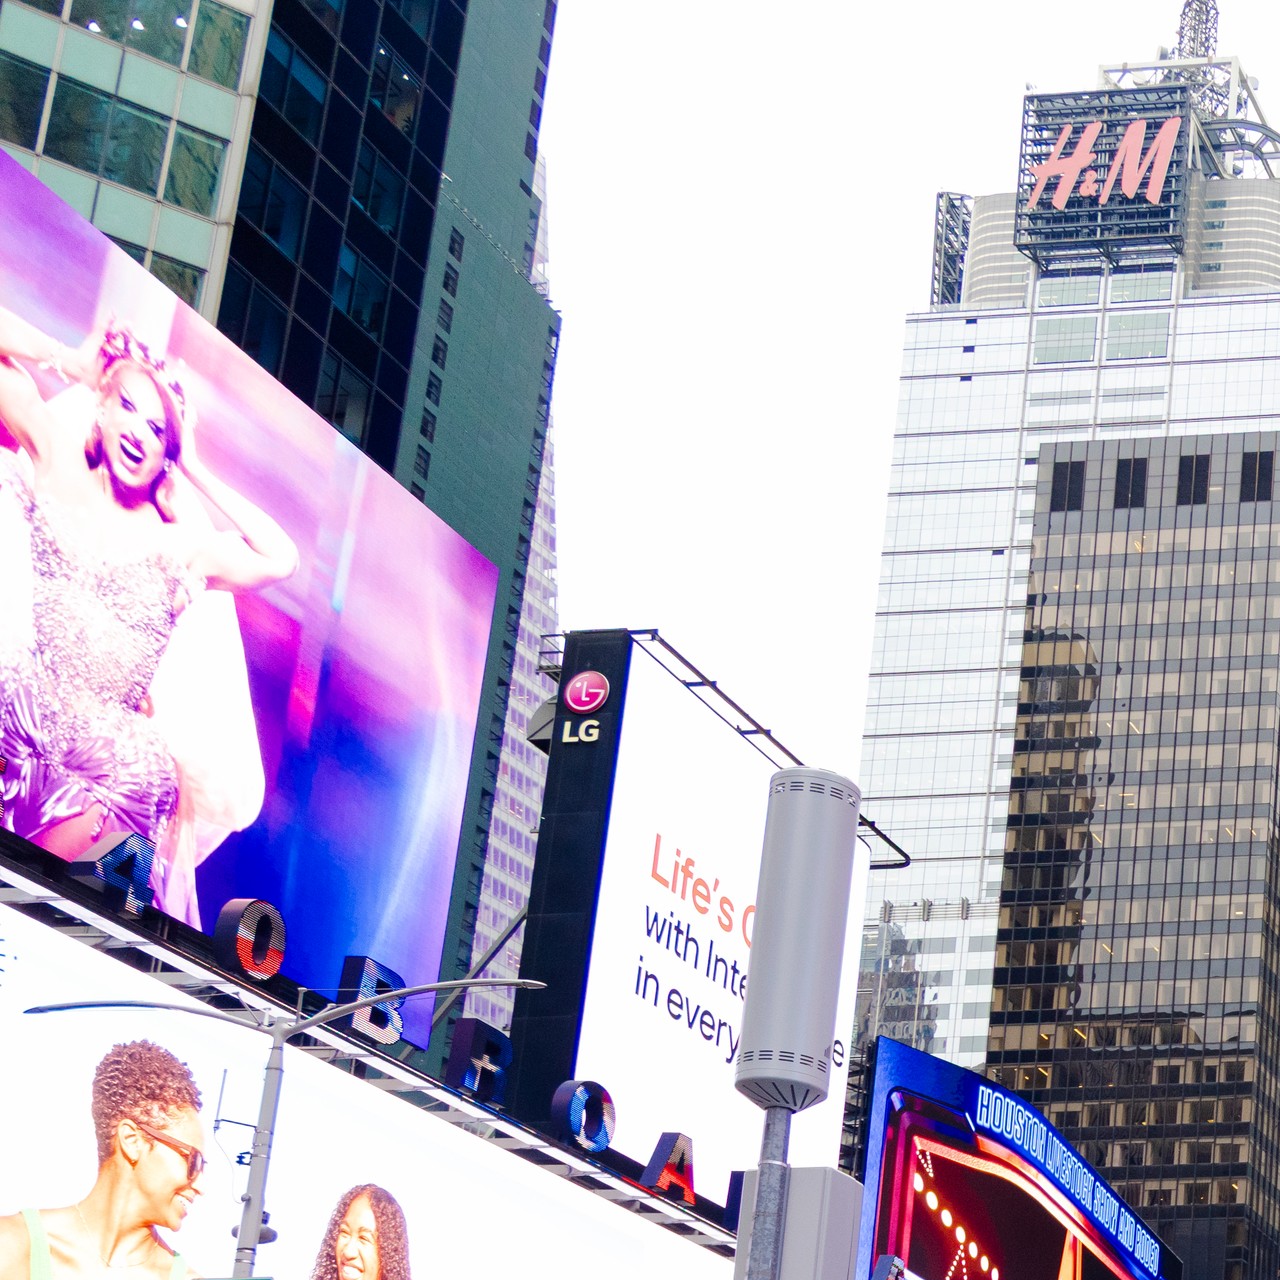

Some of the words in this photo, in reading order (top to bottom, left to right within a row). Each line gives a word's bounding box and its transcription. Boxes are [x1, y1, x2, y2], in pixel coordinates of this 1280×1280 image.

[1027, 116, 1182, 210] H&M
[561, 719, 600, 744] LG
[651, 833, 734, 935] Life's
[645, 905, 700, 971] with
[634, 956, 660, 1008] in
[667, 982, 740, 1063] every
[976, 1085, 1047, 1164] HOUSTON
[1045, 1132, 1095, 1211] LIVESTOCK
[1093, 1181, 1120, 1235] SHOW
[1118, 1207, 1135, 1252] AND
[1134, 1224, 1160, 1277] RODEO
